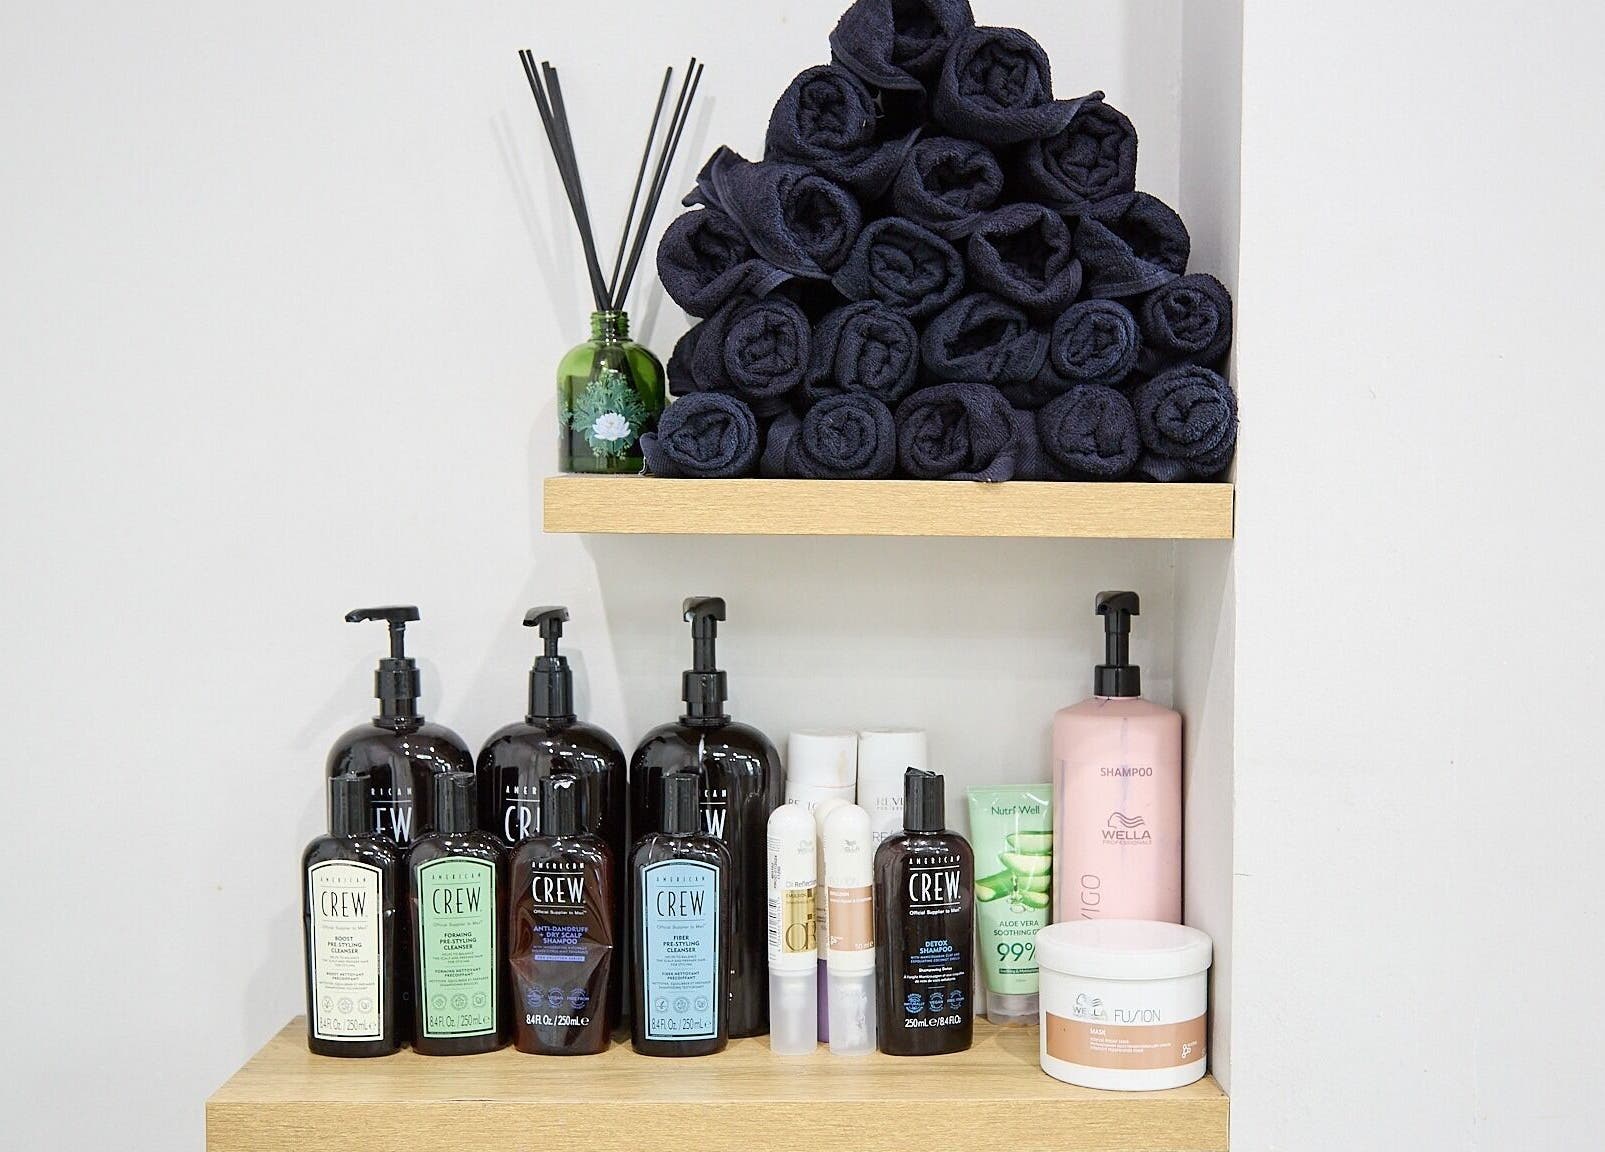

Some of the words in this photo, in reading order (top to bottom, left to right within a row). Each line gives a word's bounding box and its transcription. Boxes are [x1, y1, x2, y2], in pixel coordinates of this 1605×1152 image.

[1101, 768, 1153, 777] SHAMPOO
[371, 788, 412, 796] RICAN
[506, 786, 537, 795] AMER
[991, 805, 1016, 815] Nutri
[1019, 805, 1040, 814] Well
[376, 807, 412, 843] EW
[1102, 831, 1151, 840] WELLA
[909, 855, 960, 864] AMERICAN
[531, 861, 585, 869] AMERICAN
[532, 876, 584, 903] CREW
[909, 871, 960, 902] CREW
[432, 887, 480, 914] CREW
[657, 890, 705, 917] CREW
[919, 946, 952, 954] SHAMPOO
[997, 942, 1036, 961] 99%
[1114, 1009, 1160, 1023] FUSION
